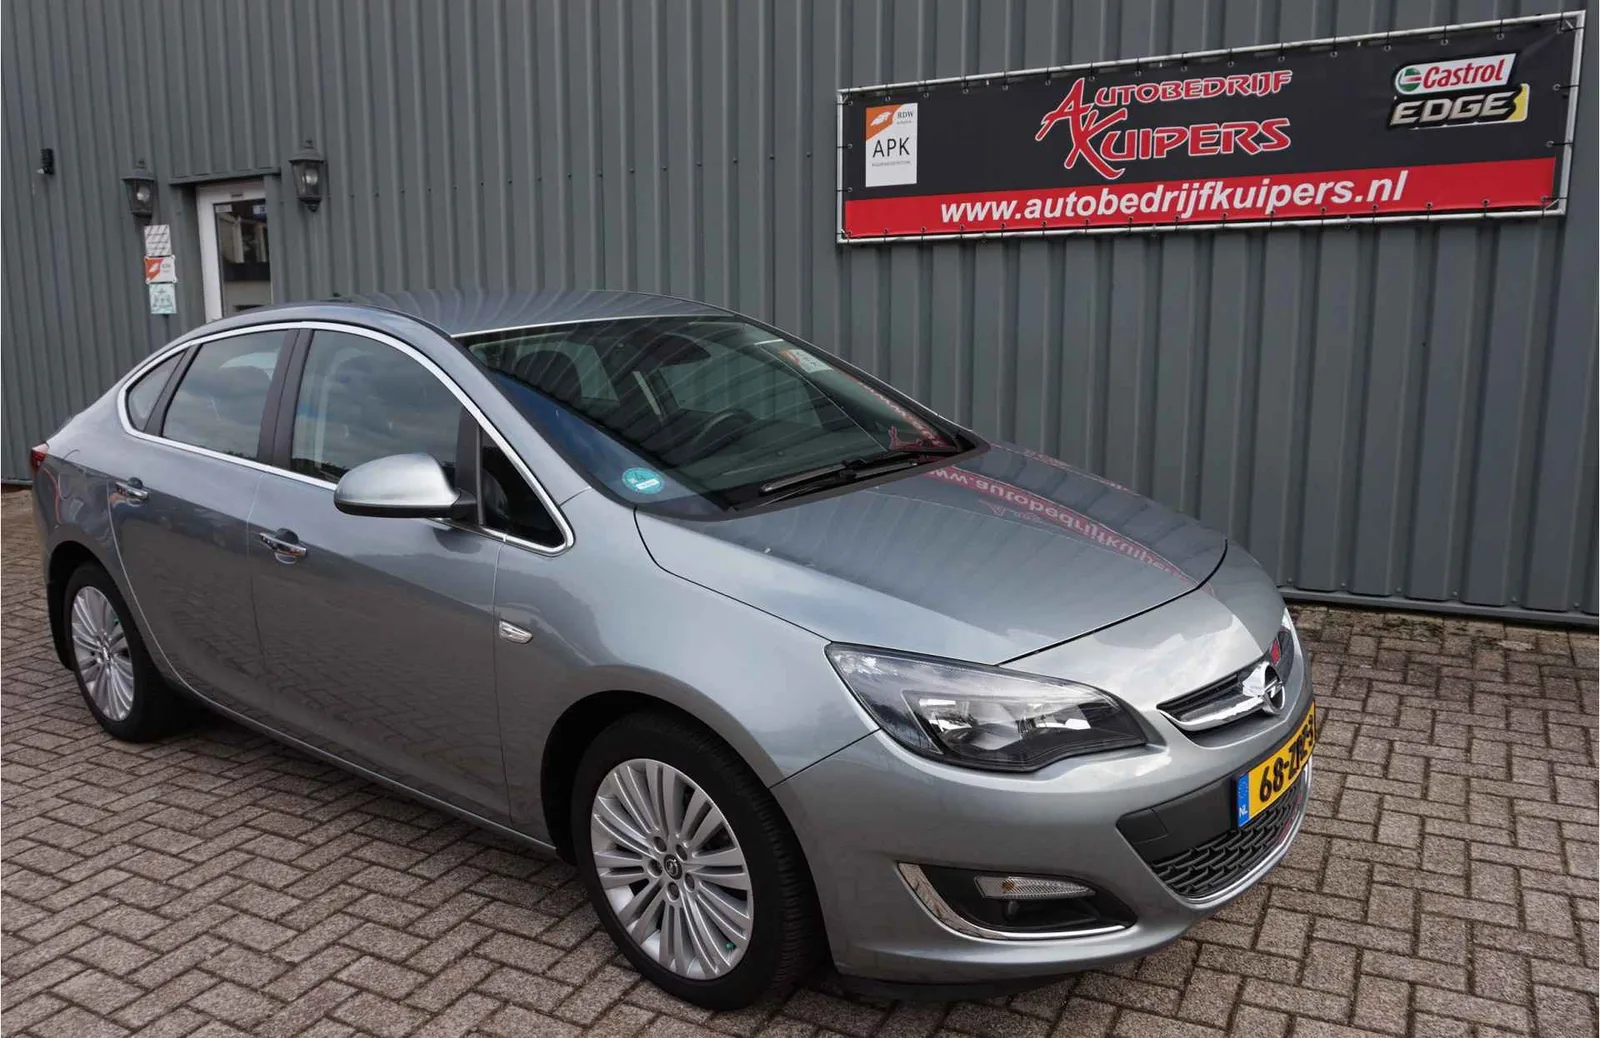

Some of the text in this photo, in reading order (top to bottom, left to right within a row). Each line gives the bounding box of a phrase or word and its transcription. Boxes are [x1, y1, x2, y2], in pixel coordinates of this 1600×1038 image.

[1423, 58, 1505, 89] Castrol
[1035, 70, 1292, 141] AUTOBEDRIJF
[1390, 91, 1516, 126] EDGE
[873, 137, 910, 158] APK
[1063, 107, 1292, 180] KUIPERS
[941, 170, 1409, 222] www.autobedrijfkuipers.nl
[1239, 804, 1248, 817] NL
